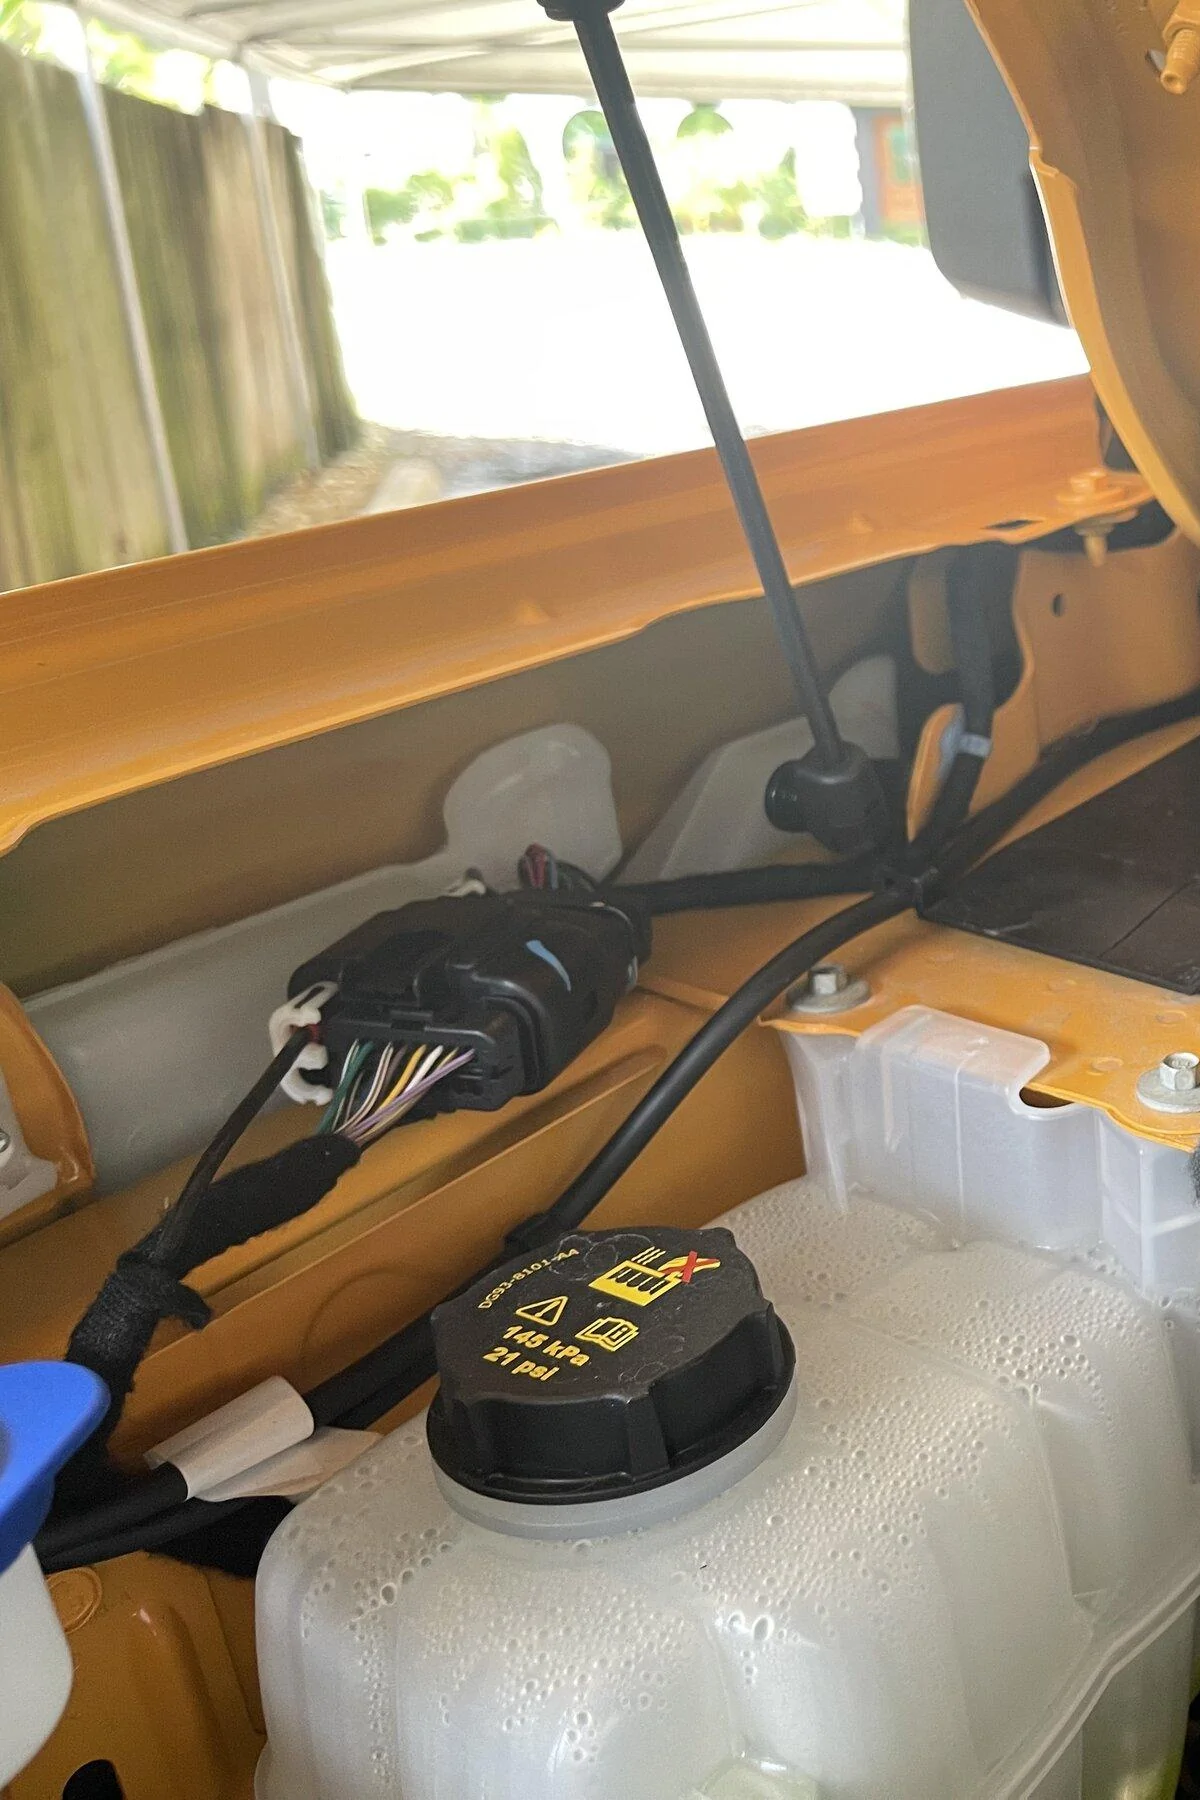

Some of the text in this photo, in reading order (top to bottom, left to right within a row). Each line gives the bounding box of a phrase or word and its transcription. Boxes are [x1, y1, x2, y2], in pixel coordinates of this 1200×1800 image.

[482, 1346, 560, 1382] 21 psi
[502, 1325, 590, 1367] 145 kPa
